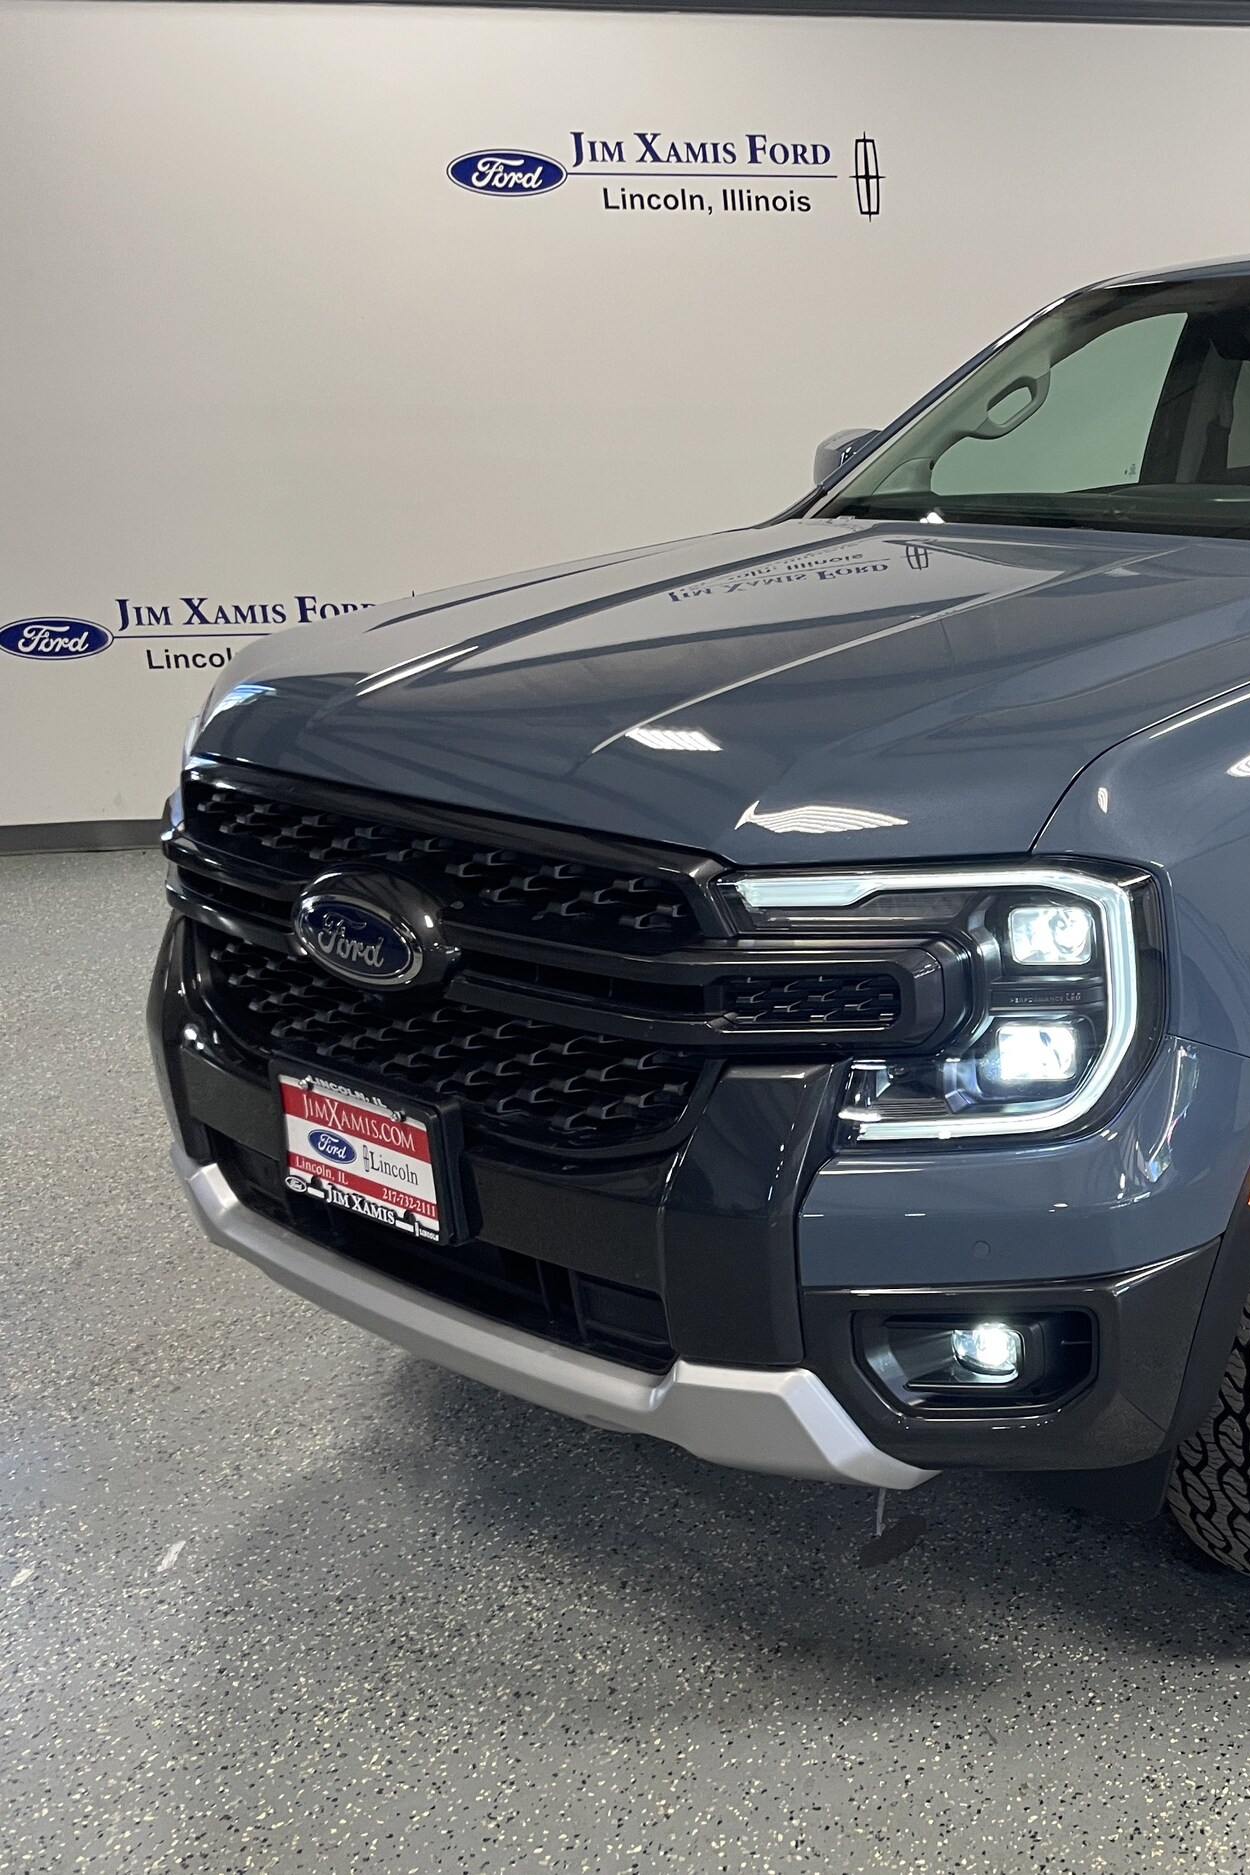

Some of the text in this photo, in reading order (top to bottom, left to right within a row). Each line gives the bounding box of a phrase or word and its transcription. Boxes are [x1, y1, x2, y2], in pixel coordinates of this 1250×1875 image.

[570, 132, 831, 168] JIM XAMIS FORD
[471, 157, 543, 189] Ford
[603, 188, 811, 216] Lincoln, Illinois
[115, 596, 376, 632] JIM XAMIS FO
[17, 625, 89, 652] Ford
[146, 647, 232, 669] Lincol
[317, 911, 385, 968] Ford
[302, 1094, 416, 1152] JIMXAMIS.COM
[317, 1135, 347, 1160] Ford
[295, 1156, 349, 1185] Lincoln, IL
[369, 1151, 419, 1186] Lincoln
[325, 1183, 395, 1225] JIM XAMIS
[382, 1187, 436, 1218] 217-732-2111
